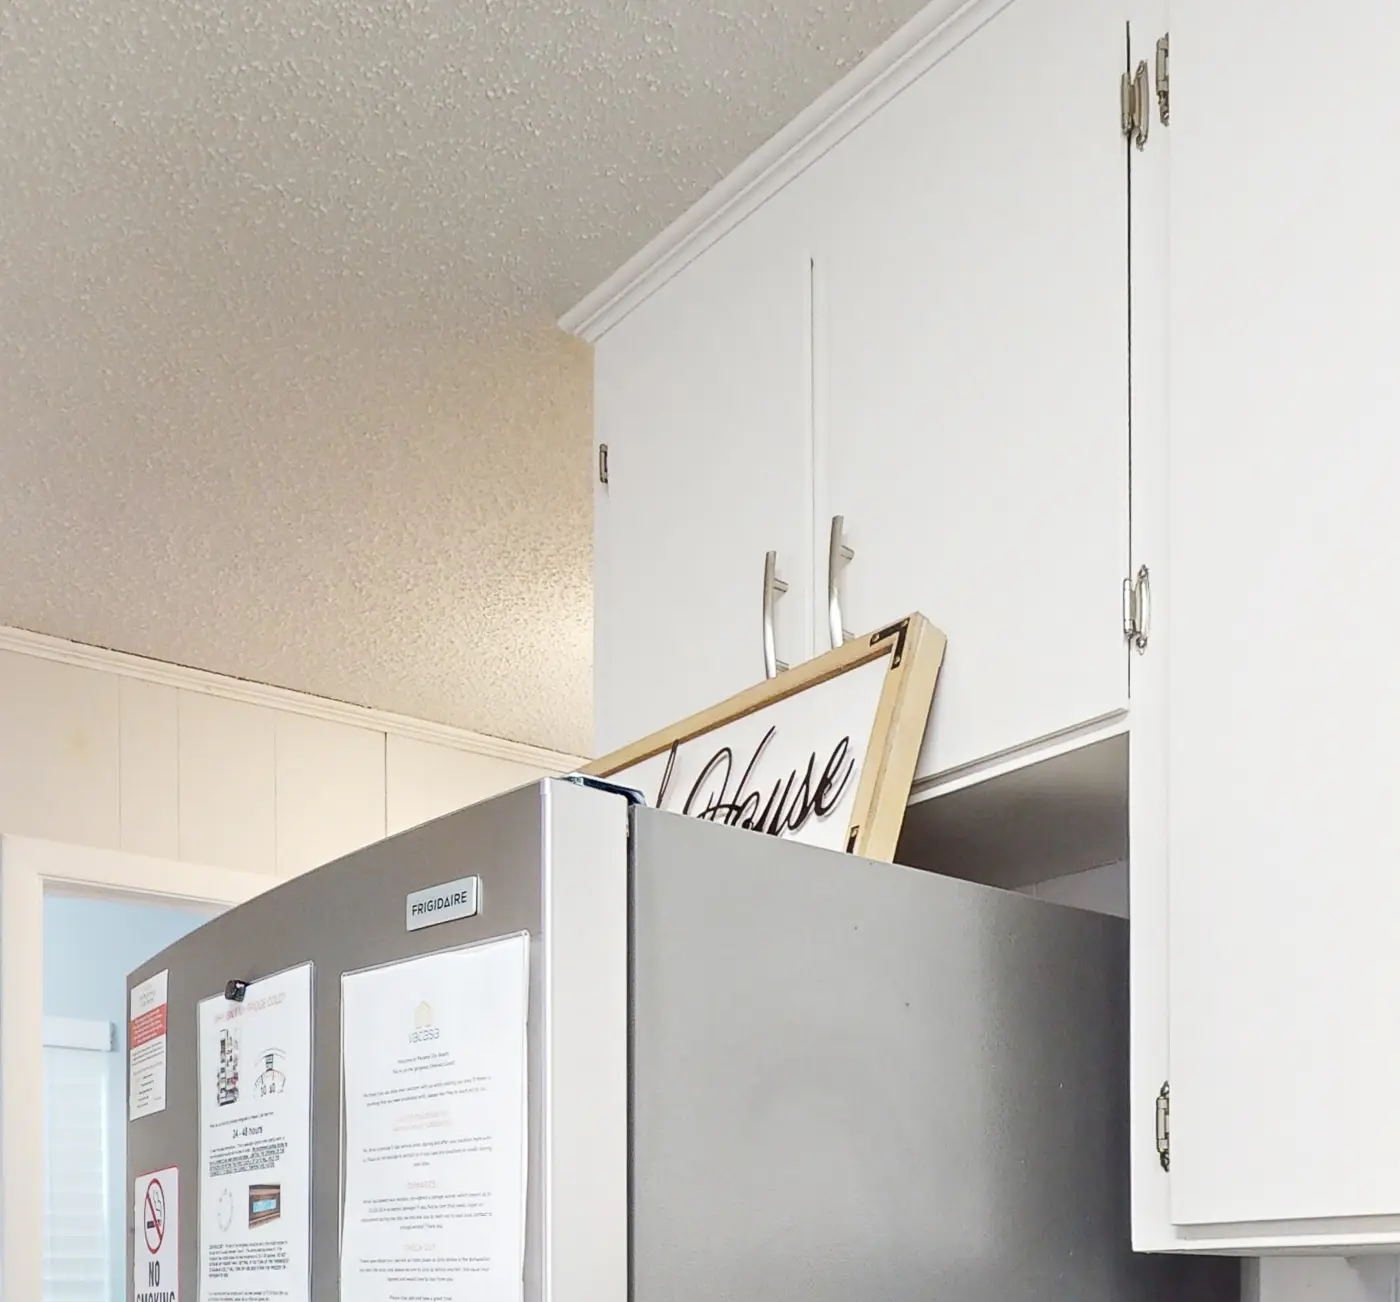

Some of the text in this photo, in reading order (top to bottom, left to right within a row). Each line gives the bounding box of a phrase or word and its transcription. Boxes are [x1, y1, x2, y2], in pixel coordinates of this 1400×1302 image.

[683, 725, 855, 837] House
[411, 890, 468, 916] FRIGIDAIRE
[408, 1027, 440, 1044] vacasa
[148, 1260, 161, 1288] NO
